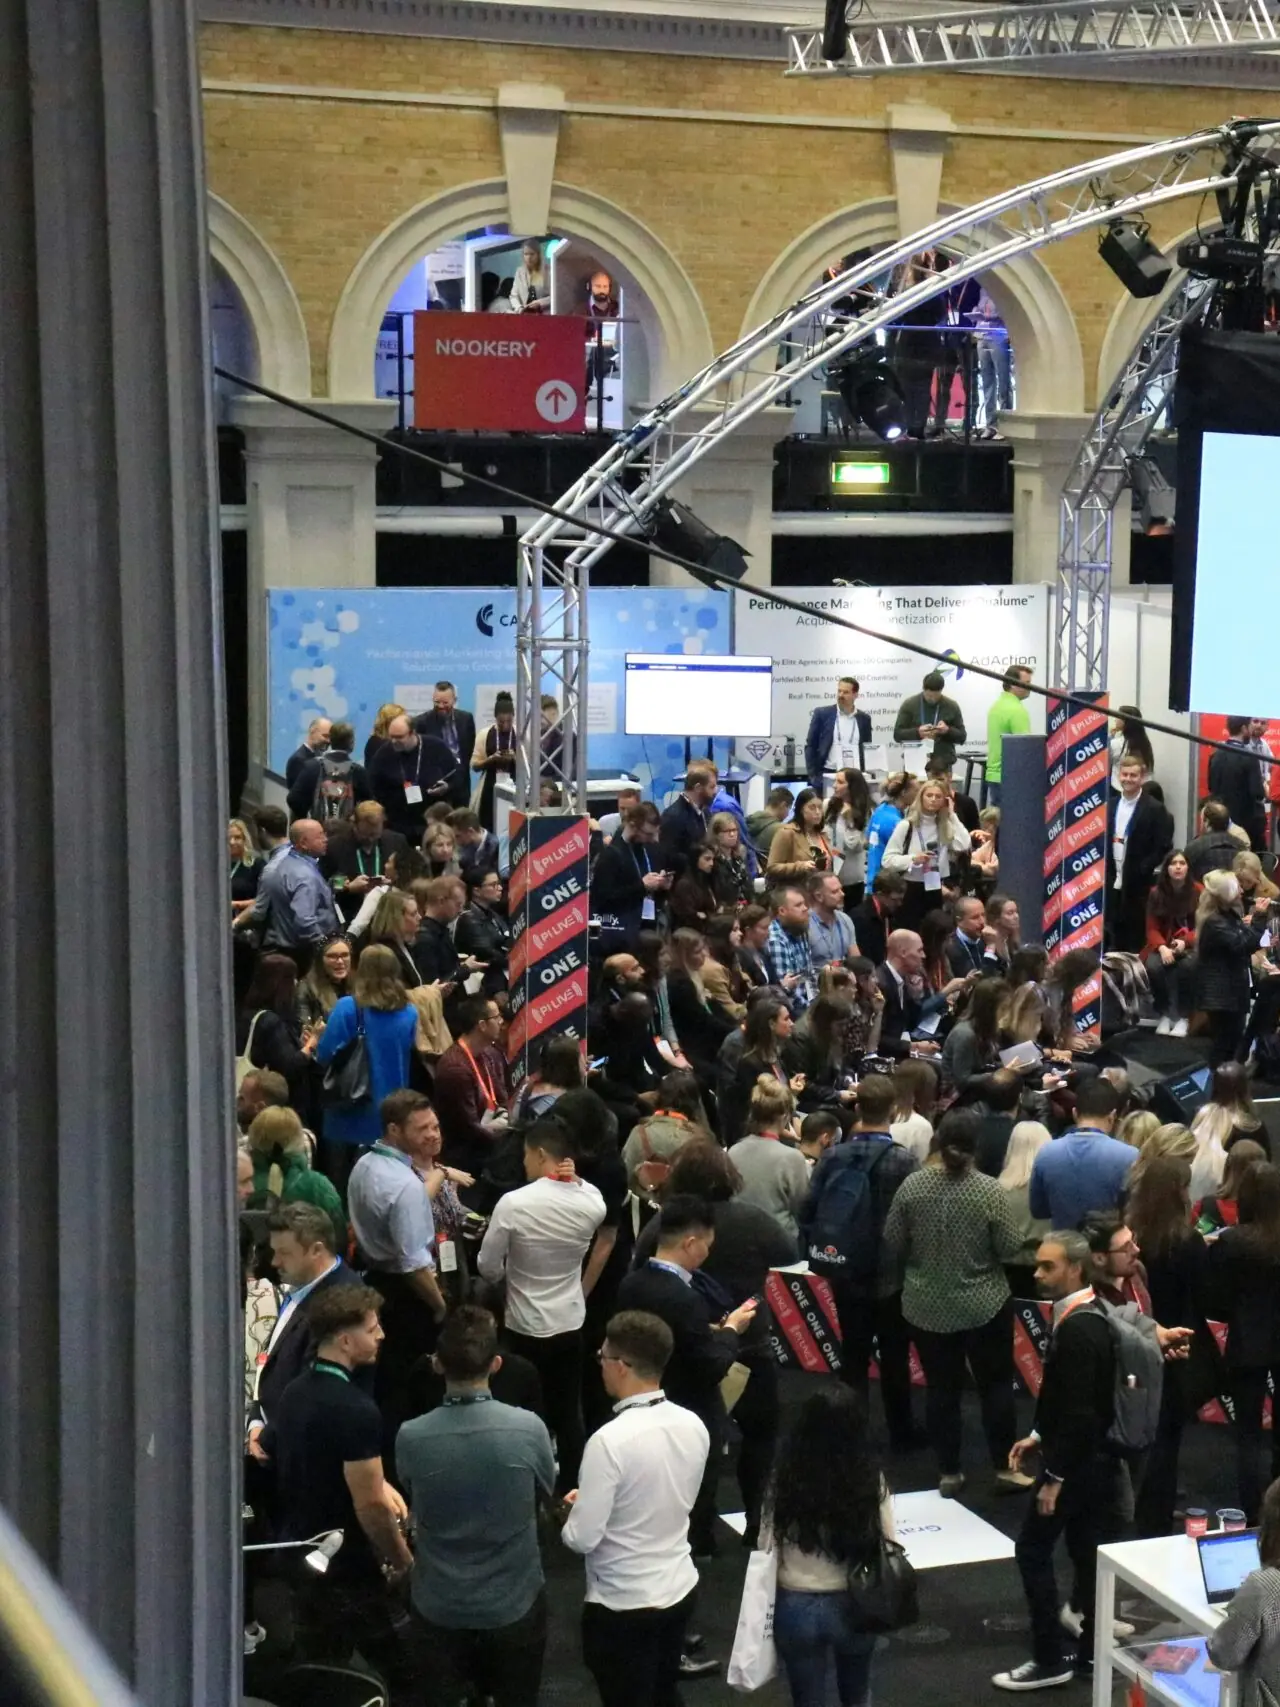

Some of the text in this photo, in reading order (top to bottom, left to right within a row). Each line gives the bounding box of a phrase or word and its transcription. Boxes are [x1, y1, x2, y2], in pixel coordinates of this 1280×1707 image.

[436, 338, 536, 358] NOOKERY
[895, 597, 921, 608] That
[970, 655, 1036, 666] AdAction
[1051, 709, 1065, 730] ONE
[1075, 738, 1103, 762] ONE
[1050, 764, 1064, 786] ONE
[1074, 793, 1102, 817] ONE
[1048, 820, 1062, 841] ONE
[512, 837, 528, 865] ONE
[553, 841, 577, 860] LIVE
[1072, 847, 1100, 871] ONE
[541, 877, 582, 910] ONE
[1047, 874, 1060, 896] ONE
[553, 915, 576, 935] LIVE
[1070, 902, 1099, 927] ONE
[512, 912, 526, 940] ONE
[1045, 929, 1059, 950] ONE
[540, 950, 581, 984] ONE
[551, 988, 575, 1009] LIVE
[1076, 1012, 1096, 1031] NE
[791, 1281, 841, 1370] ONE ONE ONE
[1023, 1309, 1041, 1336] ONE
[771, 1336, 789, 1364] ONE
